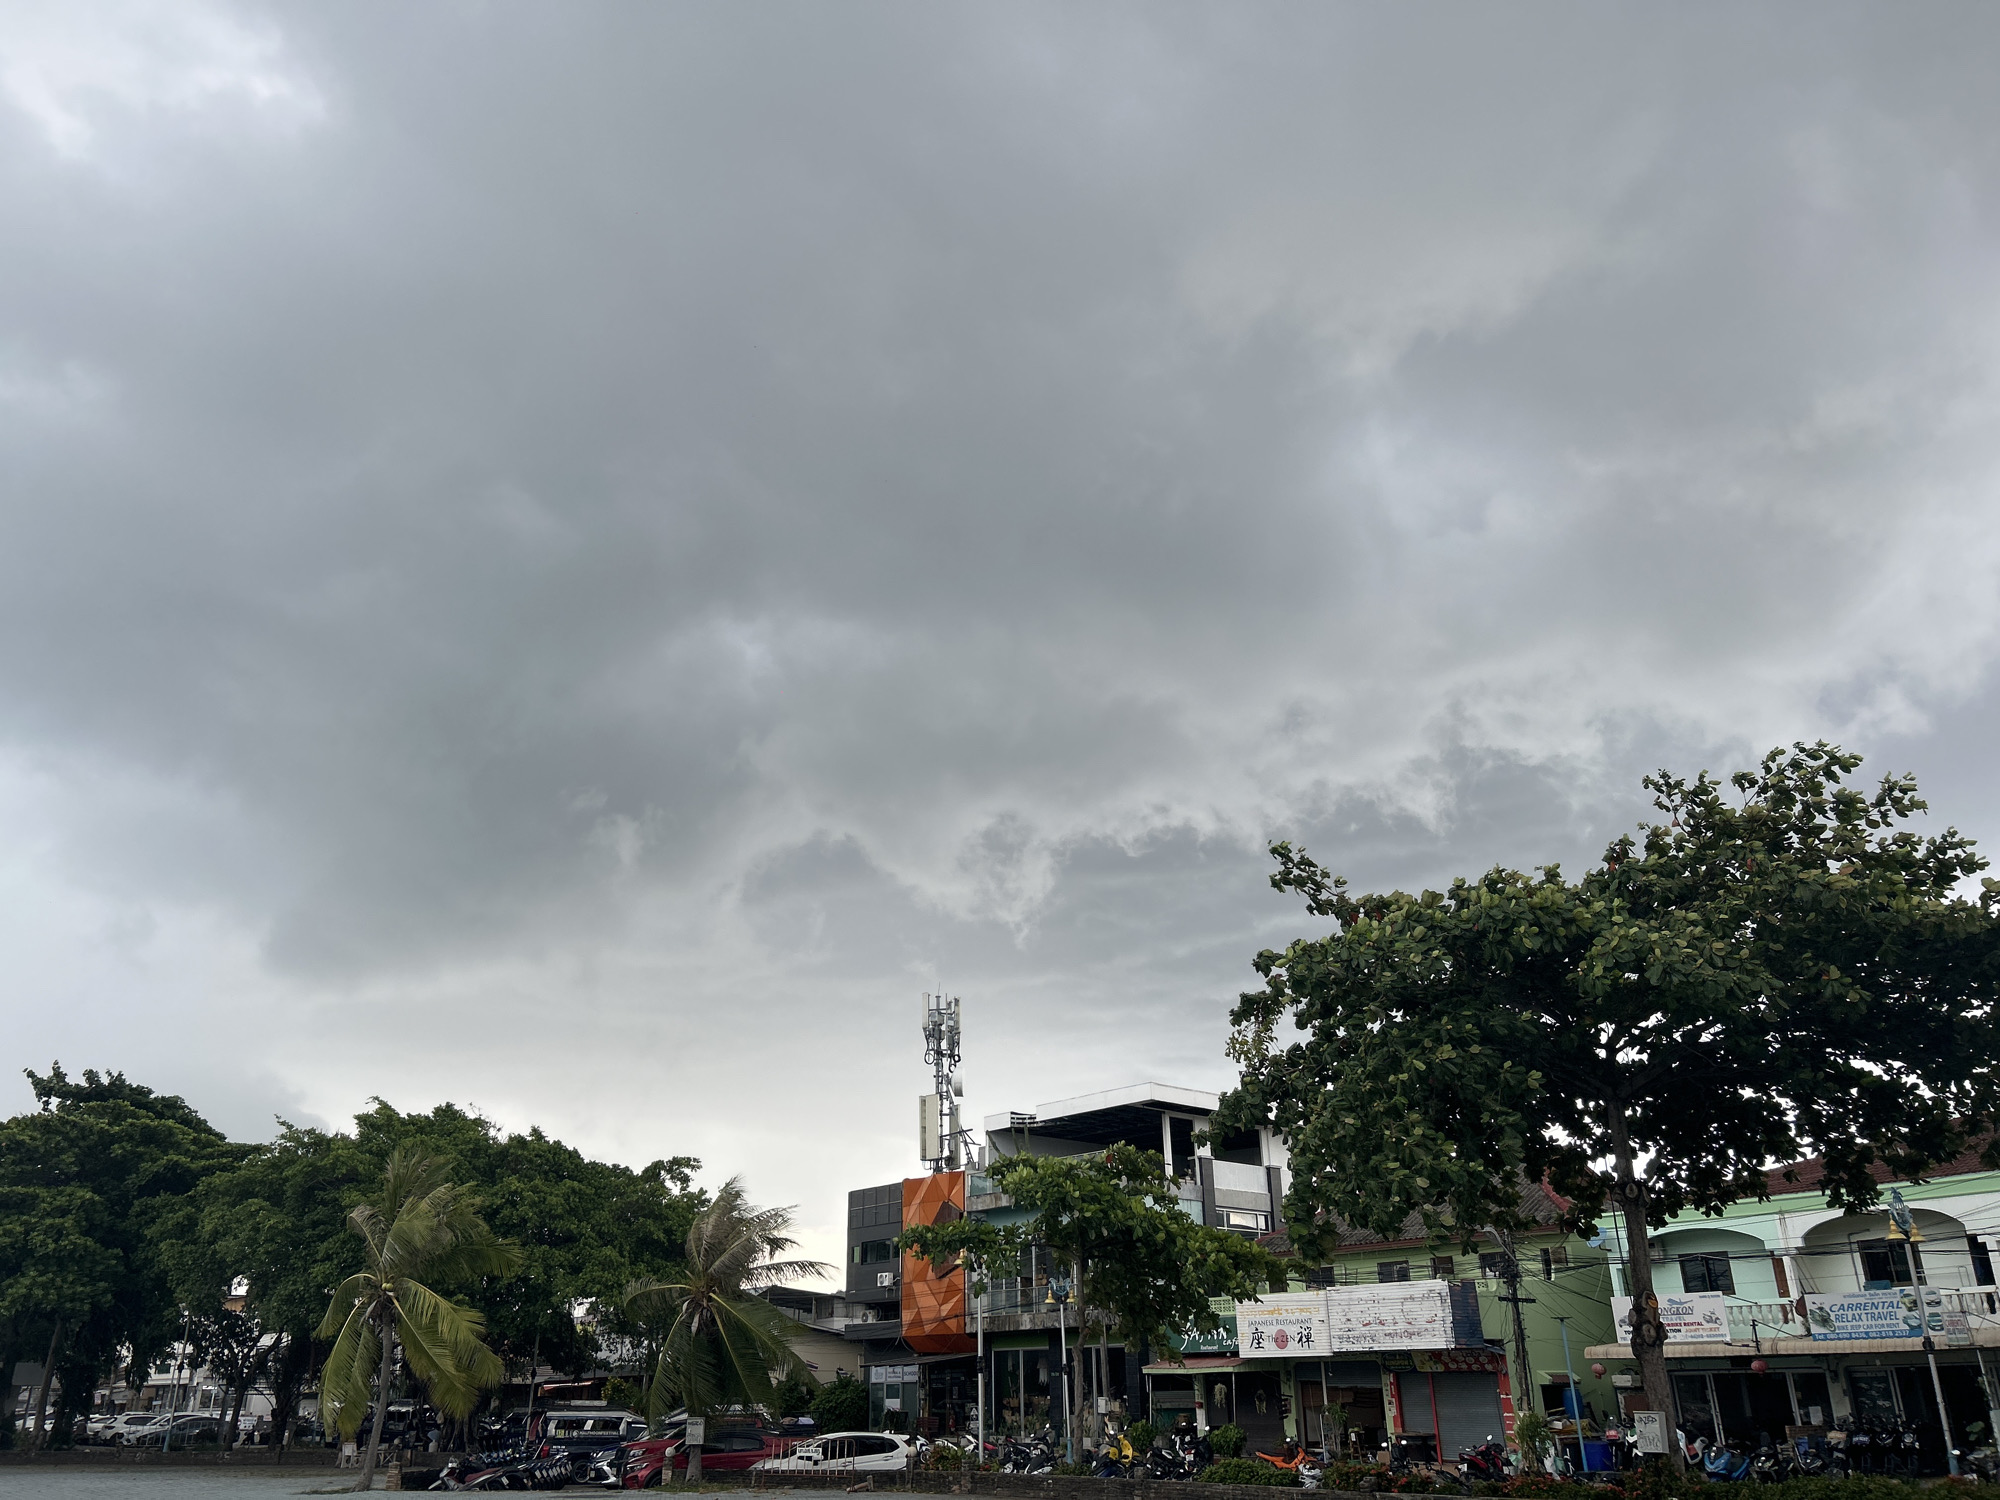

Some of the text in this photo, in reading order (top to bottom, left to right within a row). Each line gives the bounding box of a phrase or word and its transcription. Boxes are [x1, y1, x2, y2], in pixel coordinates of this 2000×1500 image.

[1658, 1306, 1694, 1315] ONGKON
[1830, 1301, 1902, 1312] CARRENTAL
[1835, 1311, 1899, 1323] RELAX TRAVEL
[1248, 1318, 1313, 1327] JAPANESE RESTAURANT
[1267, 1335, 1279, 1343] The
[1280, 1335, 1296, 1343] ZEN
